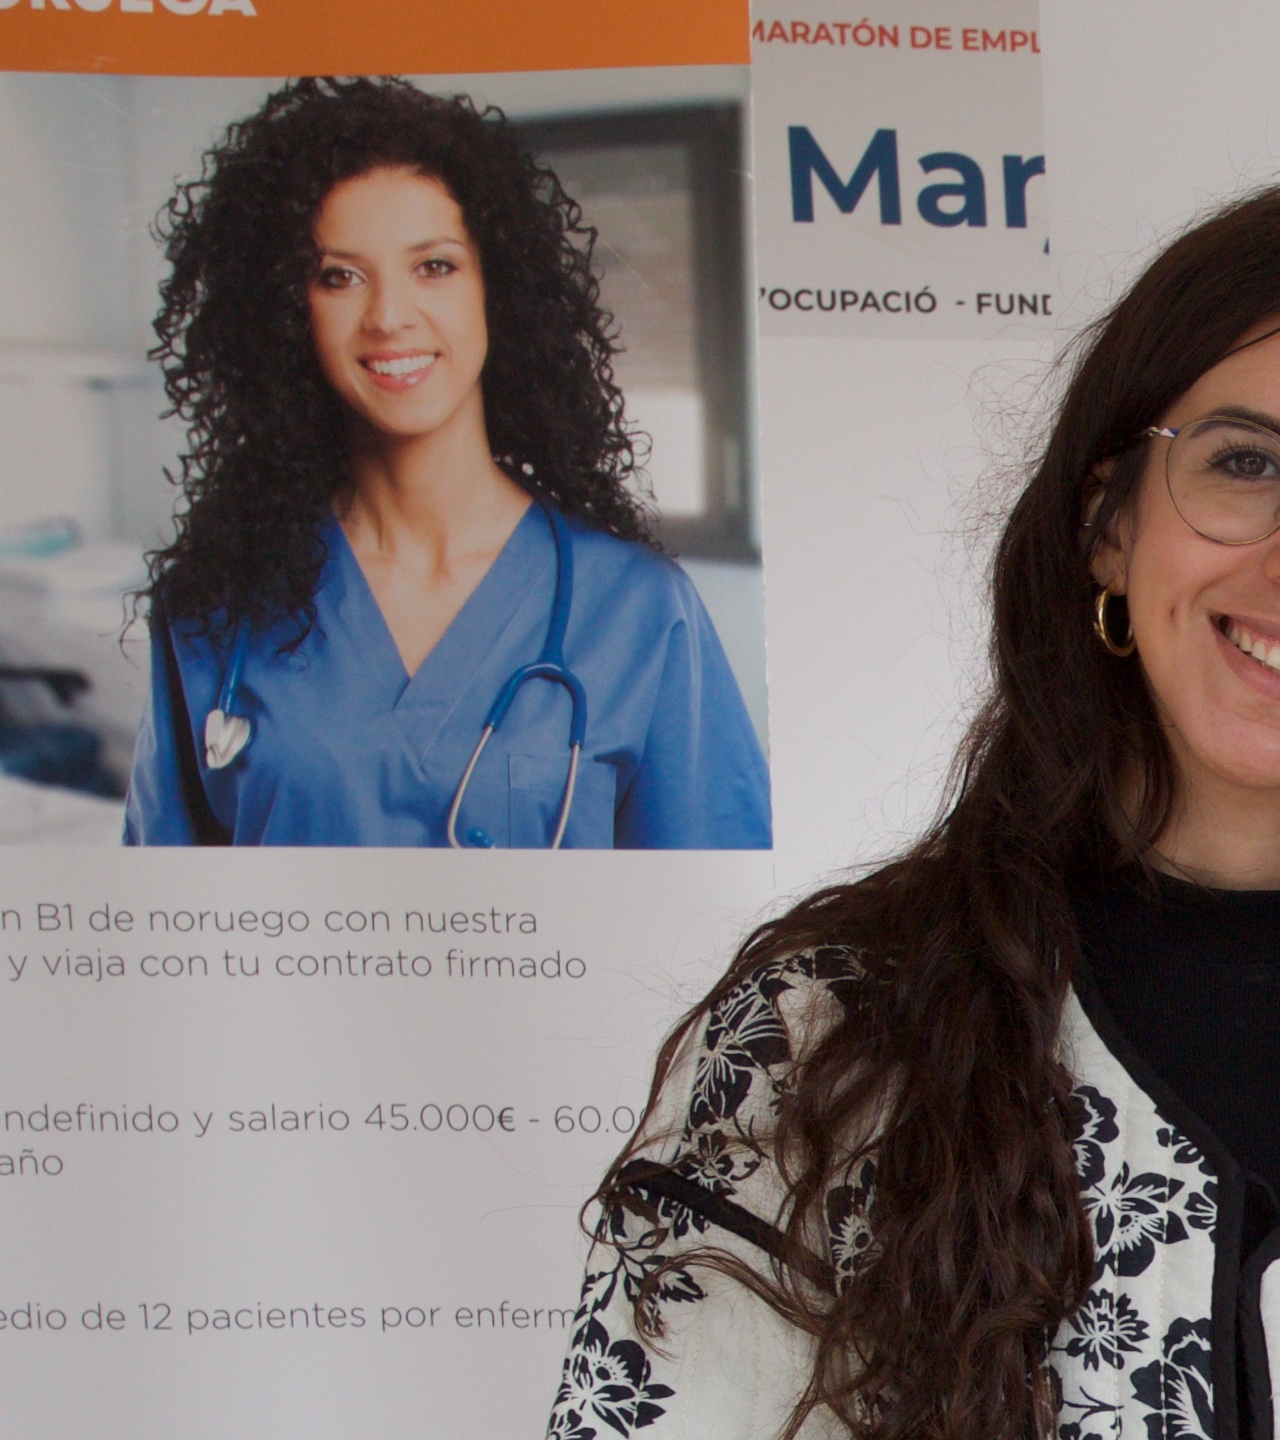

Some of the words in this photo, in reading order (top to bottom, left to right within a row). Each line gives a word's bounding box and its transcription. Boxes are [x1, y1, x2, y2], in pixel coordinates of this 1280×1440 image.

[910, 25, 953, 51] DE
[787, 124, 1050, 254] Mar
[36, 902, 74, 932] B1
[88, 902, 135, 932] de
[149, 909, 310, 939] noruego
[322, 907, 392, 935] con
[404, 903, 539, 936] nuestra
[7, 954, 29, 982] y
[42, 947, 126, 983] viaja
[139, 954, 209, 977] con
[222, 949, 260, 977] tu
[274, 951, 434, 980] contrato
[444, 947, 589, 981] firmado
[3, 1103, 180, 1133] ndefinido
[193, 1108, 215, 1139] y
[228, 1102, 351, 1134] salario
[362, 1102, 518, 1134] 45.000€
[0, 1147, 64, 1177] año
[81, 1301, 126, 1331] de
[137, 1302, 173, 1331] 12
[187, 1299, 367, 1335] pacientes
[380, 1305, 443, 1335] por
